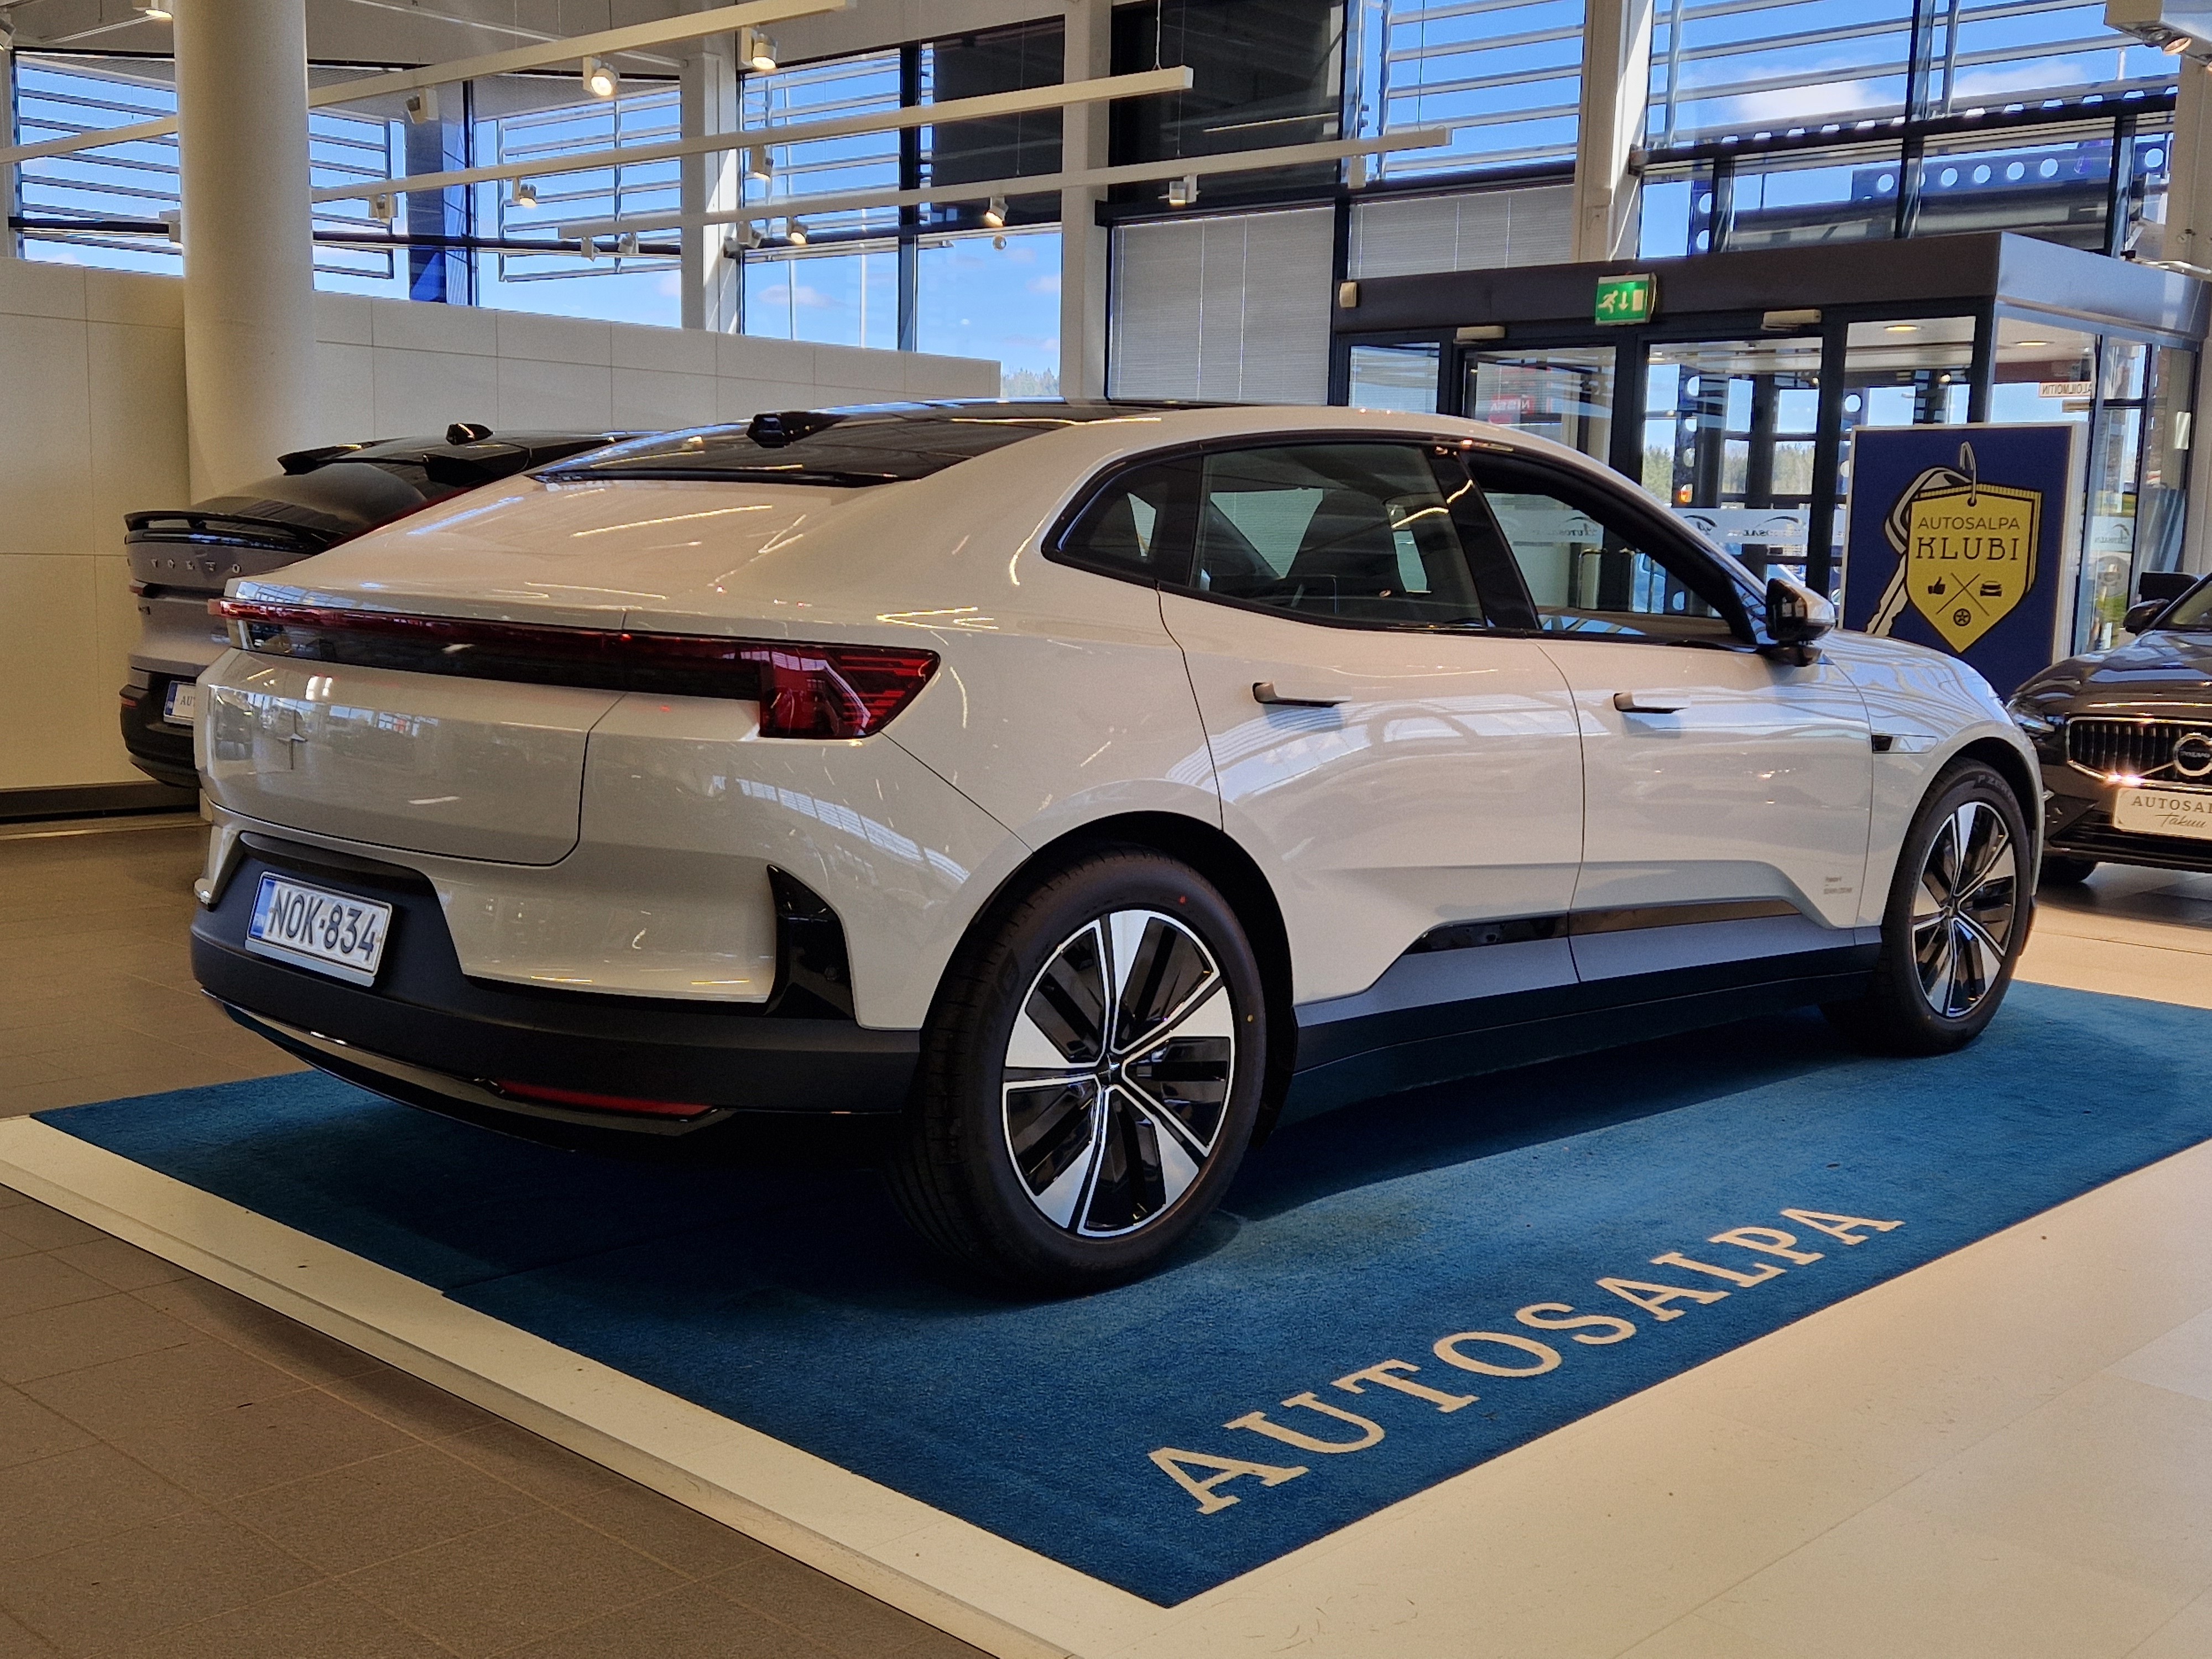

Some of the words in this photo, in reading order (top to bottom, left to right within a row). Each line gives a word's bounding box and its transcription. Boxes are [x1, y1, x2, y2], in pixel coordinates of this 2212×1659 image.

[1918, 517, 2020, 530] AUTOSALPA
[1916, 537, 2019, 560] KLUBI
[2155, 812, 2207, 828] Takuu
[268, 888, 375, 961] NOK-834
[1147, 1208, 1905, 1514] AUTOSALPA
